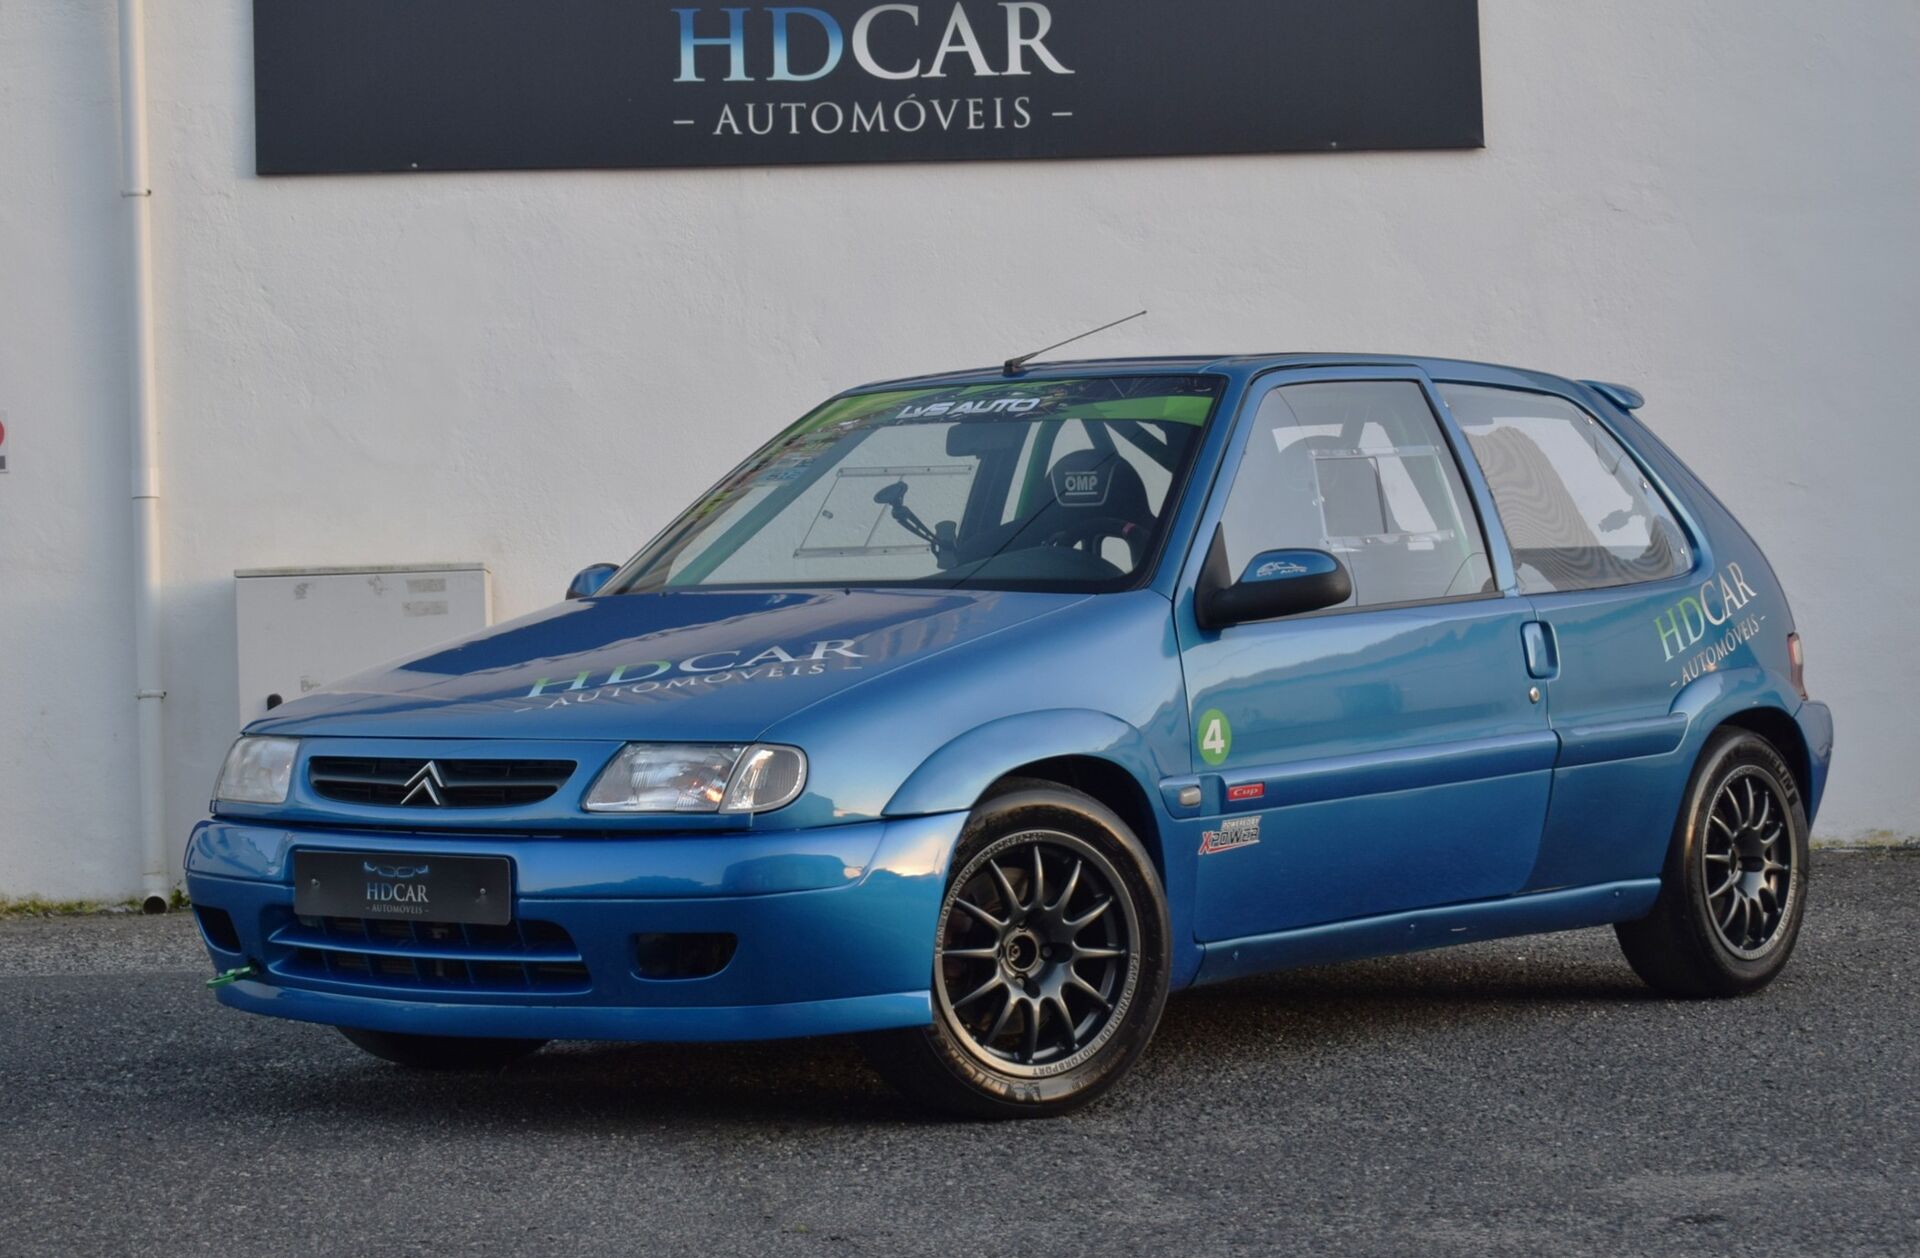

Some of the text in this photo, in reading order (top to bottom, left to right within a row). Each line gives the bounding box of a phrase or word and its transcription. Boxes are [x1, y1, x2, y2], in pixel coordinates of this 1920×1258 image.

[671, 1, 1075, 82] HDCAR
[712, 93, 1031, 135] AUTOMÓVEIS
[1065, 475, 1098, 491] OMP
[1654, 562, 1757, 662] HDCAR
[527, 639, 869, 698] HDCAR
[1203, 718, 1225, 754] 4
[1233, 788, 1259, 797] Cup
[366, 881, 429, 903] HDCAR
